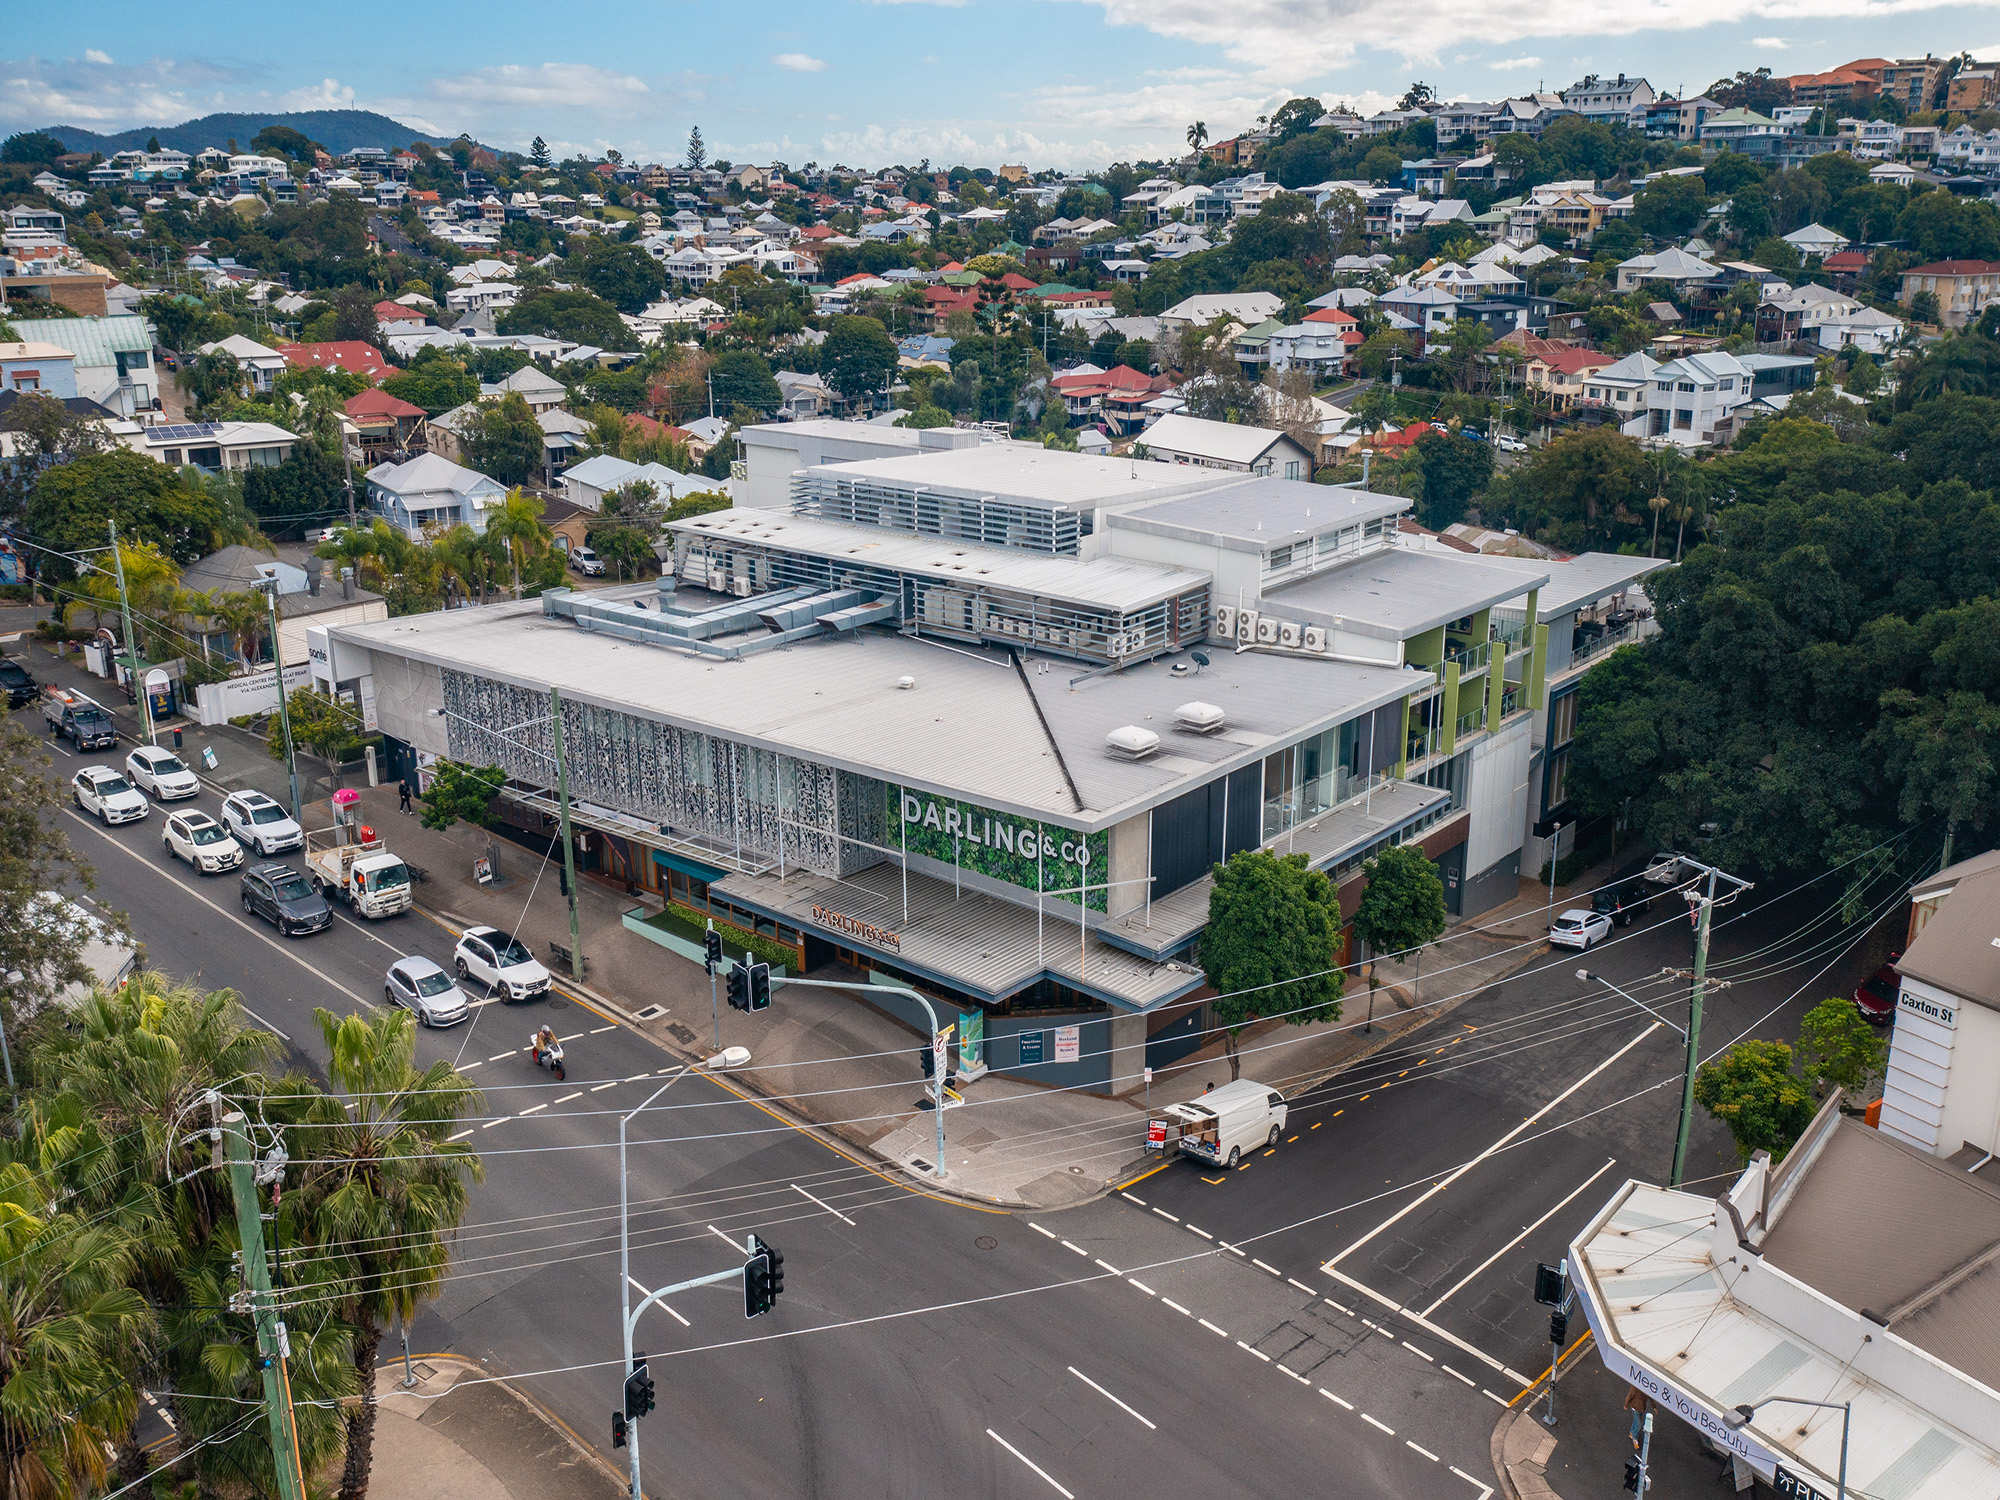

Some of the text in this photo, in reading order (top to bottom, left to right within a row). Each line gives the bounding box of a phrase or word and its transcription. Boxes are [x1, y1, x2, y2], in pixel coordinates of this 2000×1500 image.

[904, 795, 1037, 859] DARLING
[1061, 841, 1091, 866] CO
[812, 904, 876, 940] DARLING
[1902, 993, 1952, 1023] Caxton St
[1629, 1365, 1749, 1457] Mee & You Beauty
